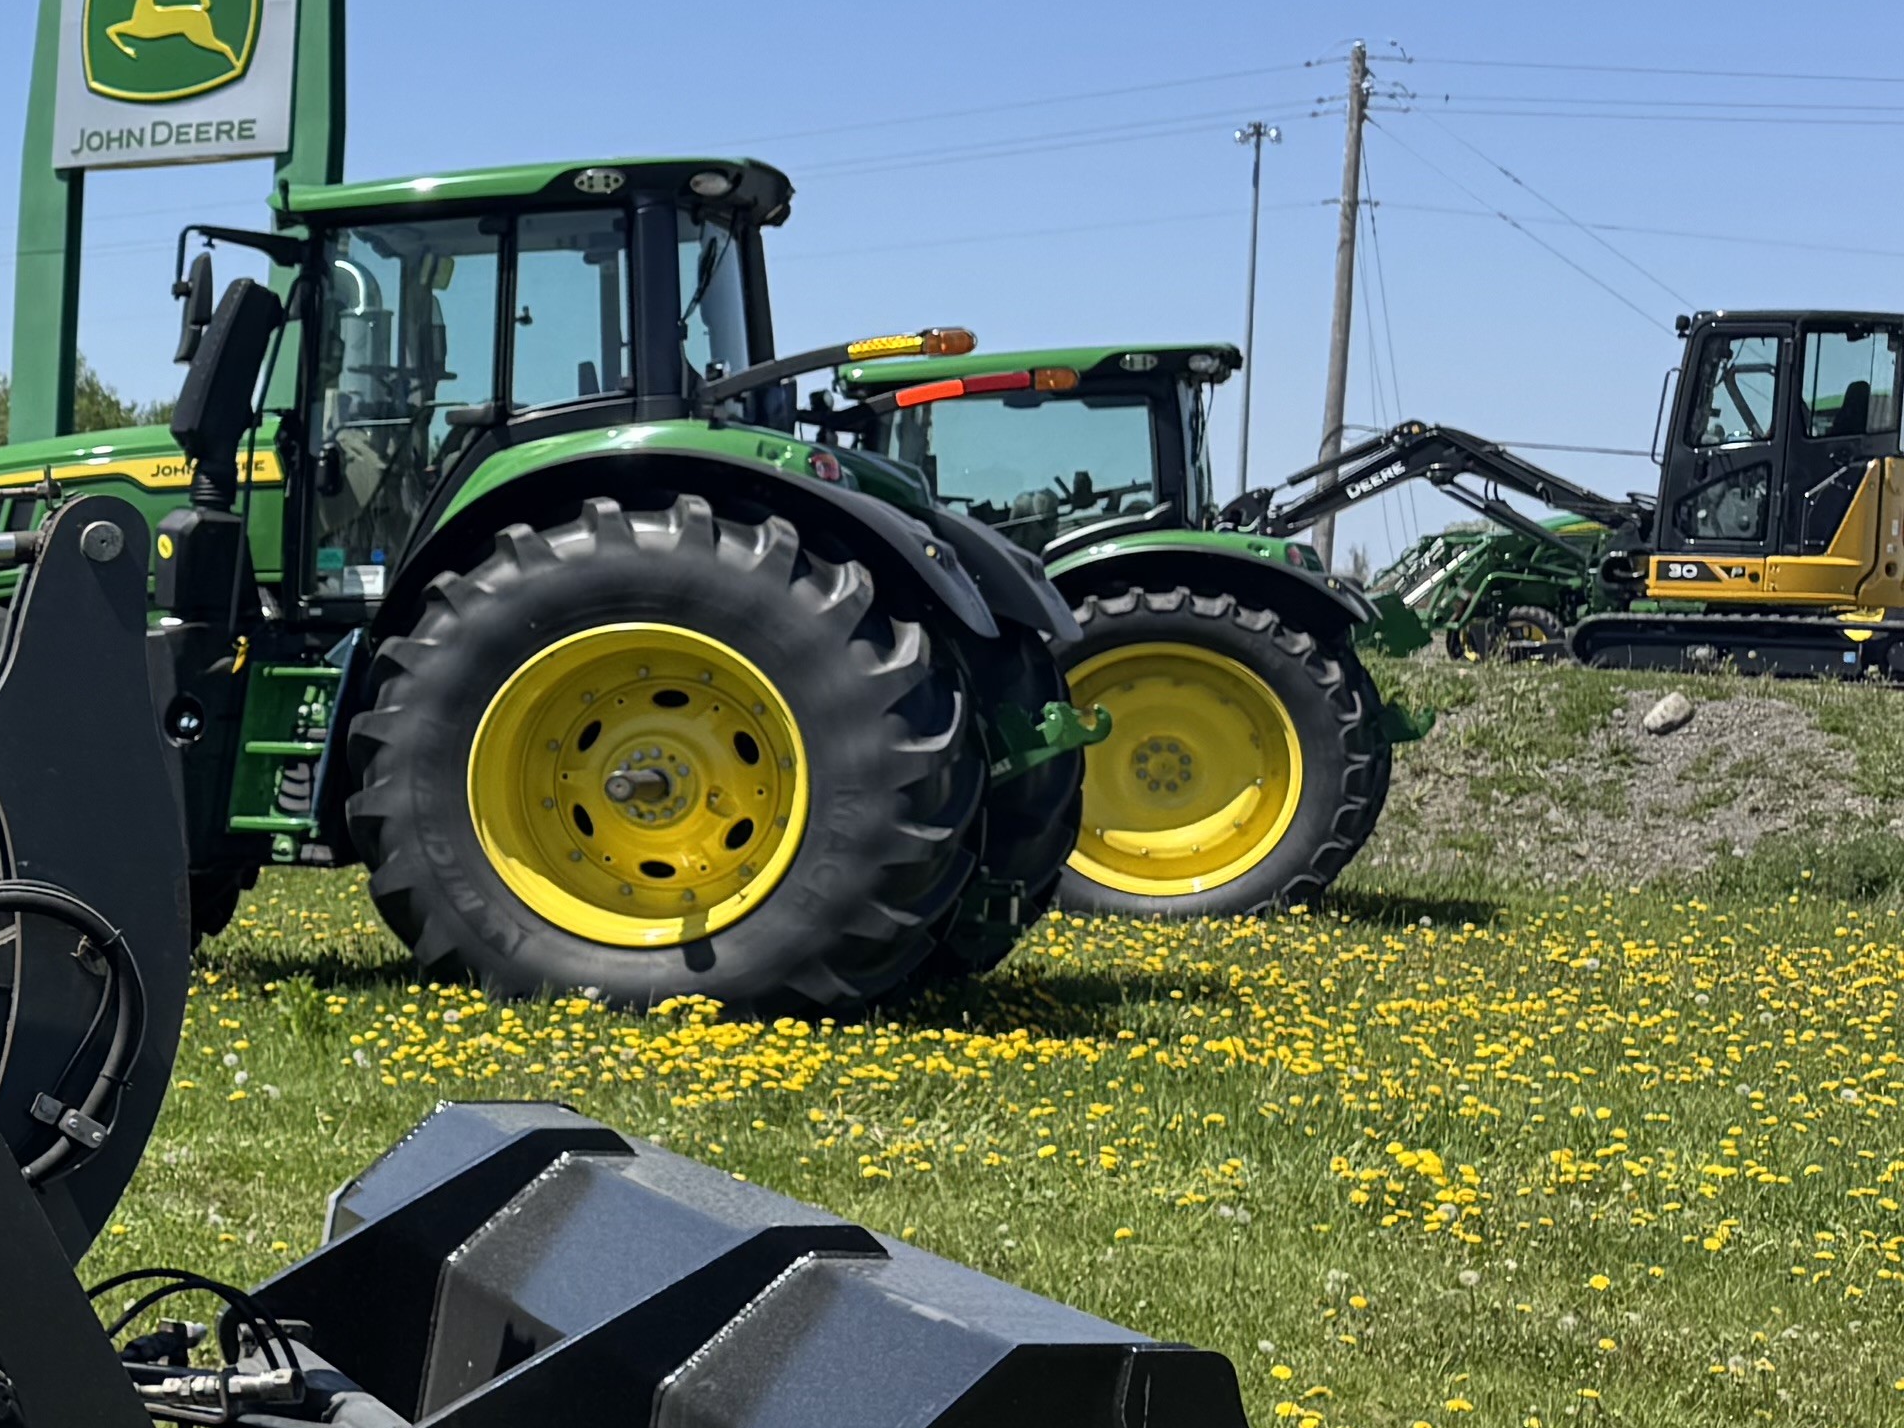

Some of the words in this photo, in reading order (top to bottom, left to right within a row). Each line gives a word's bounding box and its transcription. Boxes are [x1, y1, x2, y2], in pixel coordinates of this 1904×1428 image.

[70, 126, 145, 155] JOHN
[150, 118, 257, 148] DEERE
[1345, 460, 1406, 500] DEERE
